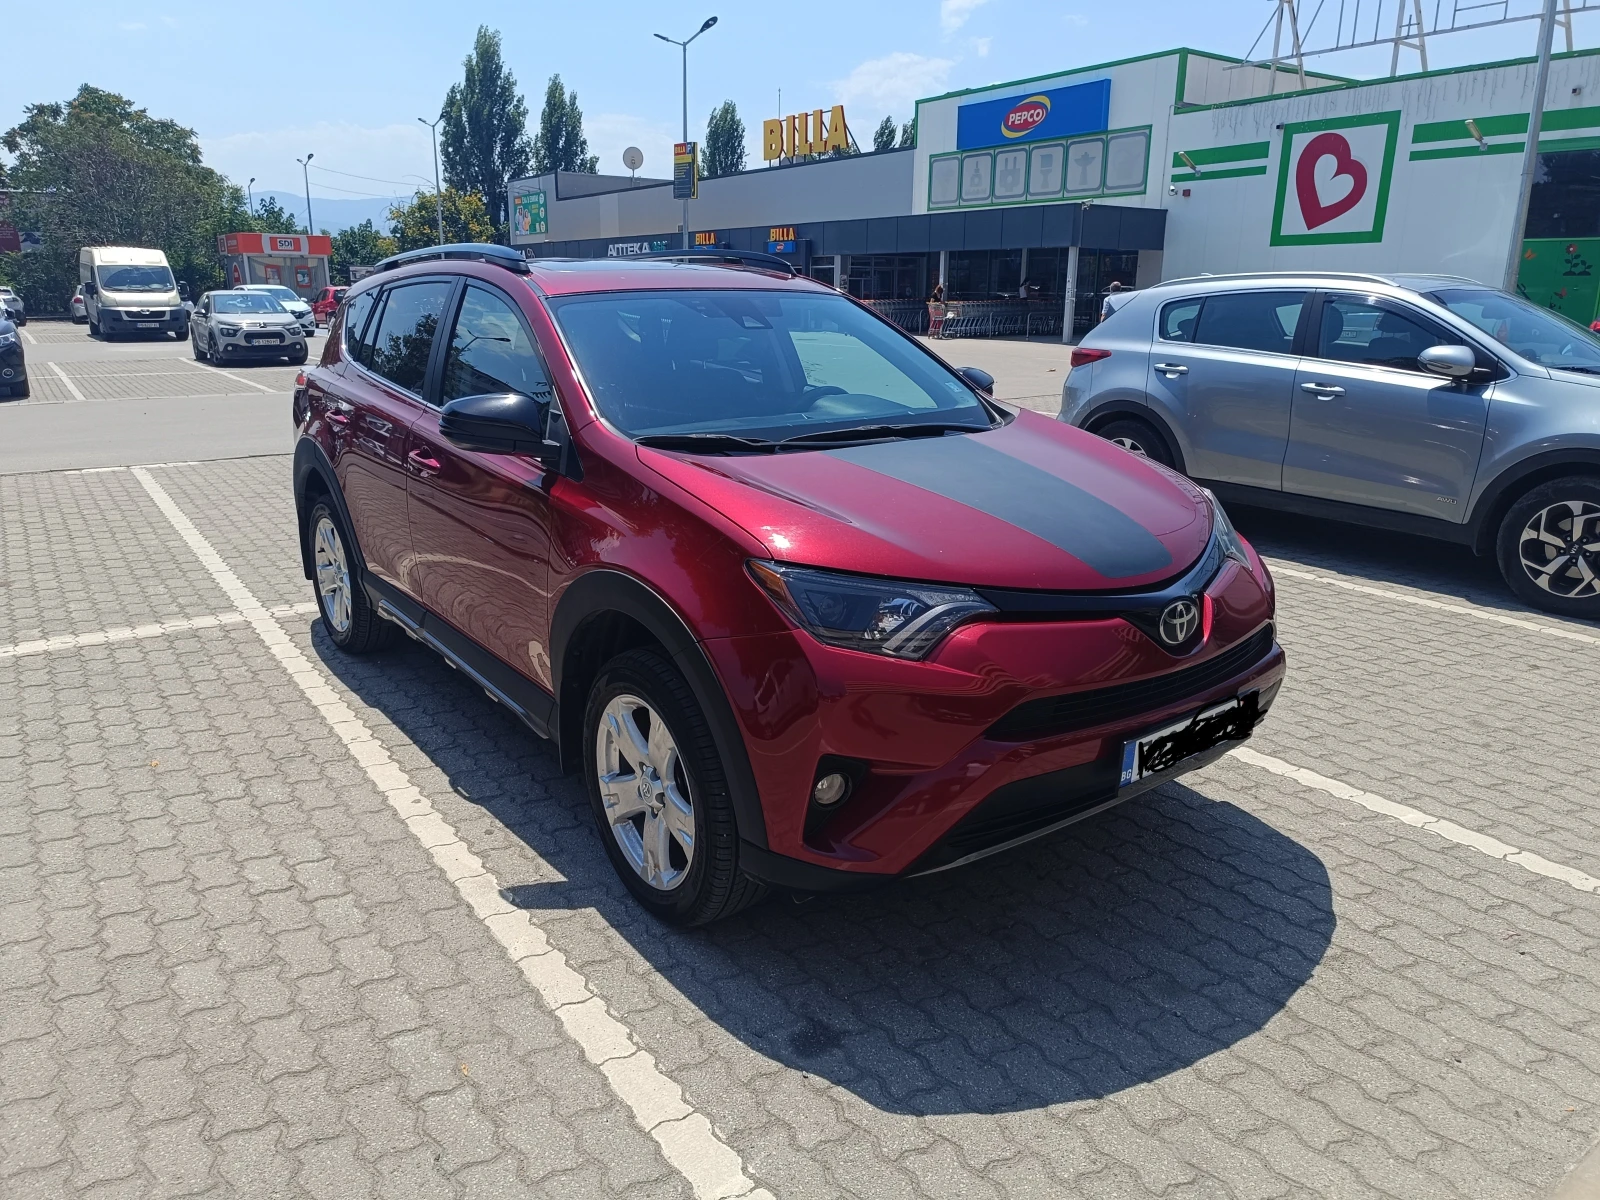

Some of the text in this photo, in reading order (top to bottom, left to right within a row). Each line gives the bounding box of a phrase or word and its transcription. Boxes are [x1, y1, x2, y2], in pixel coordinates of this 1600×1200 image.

[1008, 108, 1043, 126] PEPCO
[763, 105, 849, 160] BILLA
[695, 232, 715, 245] BILLA
[769, 227, 795, 241] BILLA
[278, 239, 293, 247] SDI
[607, 242, 650, 257] АПТЕКА
[1121, 769, 1132, 781] BG
